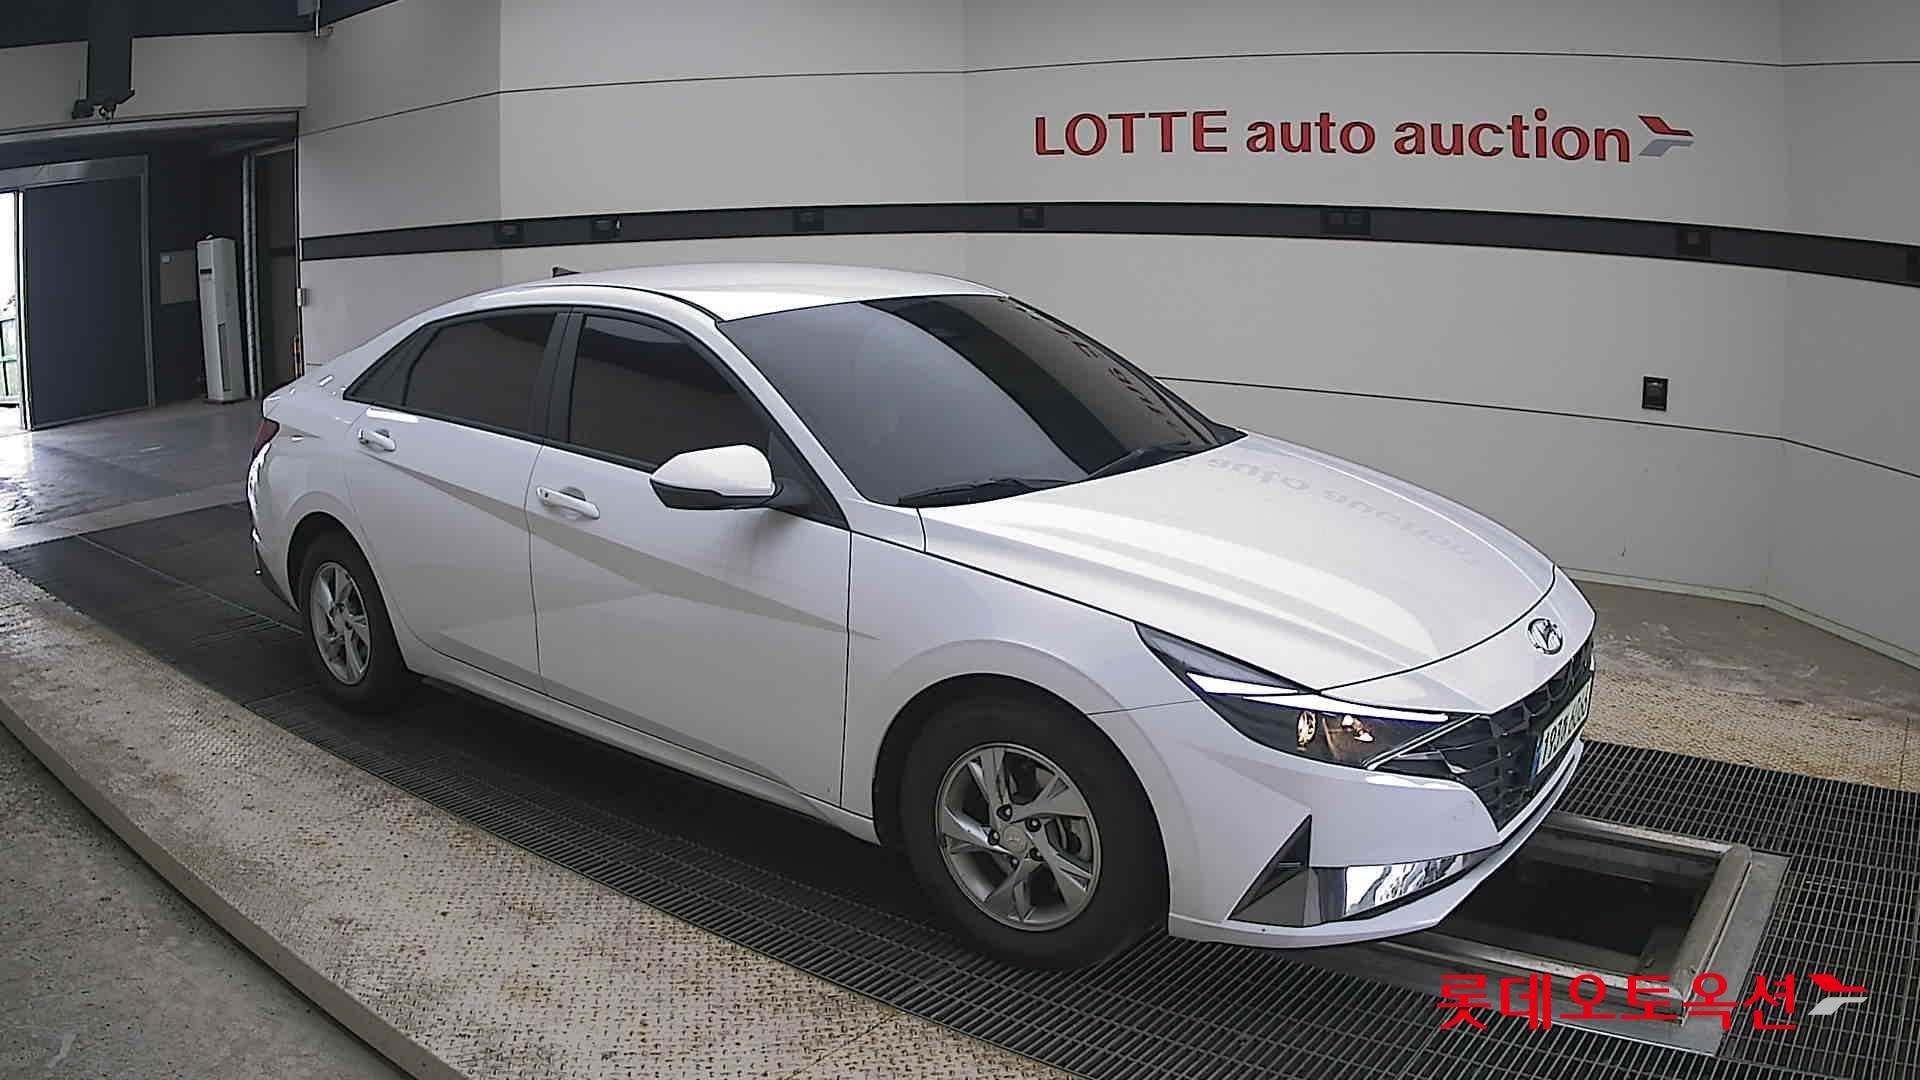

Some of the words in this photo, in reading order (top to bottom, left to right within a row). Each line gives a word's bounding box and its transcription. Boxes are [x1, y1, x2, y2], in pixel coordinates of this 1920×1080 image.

[1034, 110, 1228, 156] LOTTE
[1246, 112, 1376, 154] auto
[1394, 107, 1632, 163] auction
